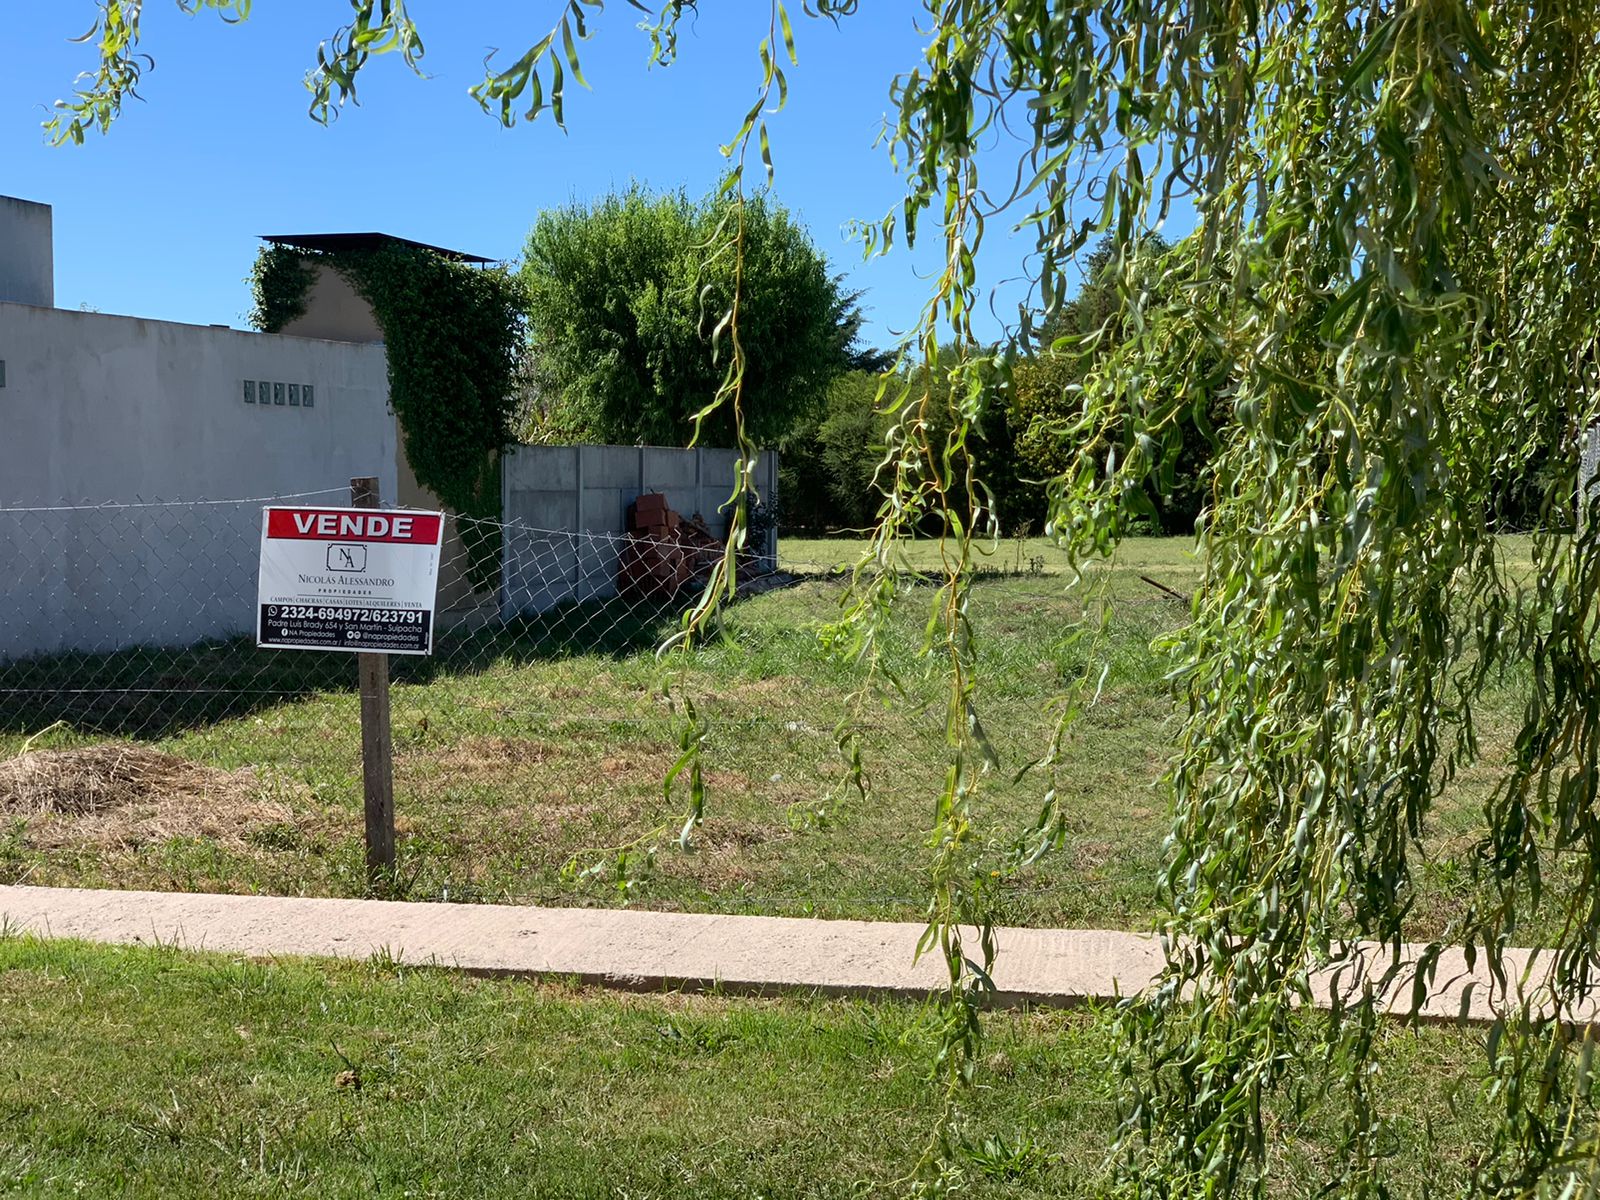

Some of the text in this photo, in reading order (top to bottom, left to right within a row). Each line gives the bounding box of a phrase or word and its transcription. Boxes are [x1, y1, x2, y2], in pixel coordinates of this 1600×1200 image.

[293, 513, 413, 538] VENDE
[338, 575, 395, 587] ALESSANDRO
[281, 606, 423, 624] 2324-694972/623791
[268, 619, 289, 627] Padre
[289, 620, 302, 628] Luis
[303, 620, 324, 630] Brady
[359, 622, 383, 631] Martín
[388, 624, 423, 634] Suipacha
[299, 630, 336, 638] Propiedades
[362, 632, 419, 641] @napropiedades
